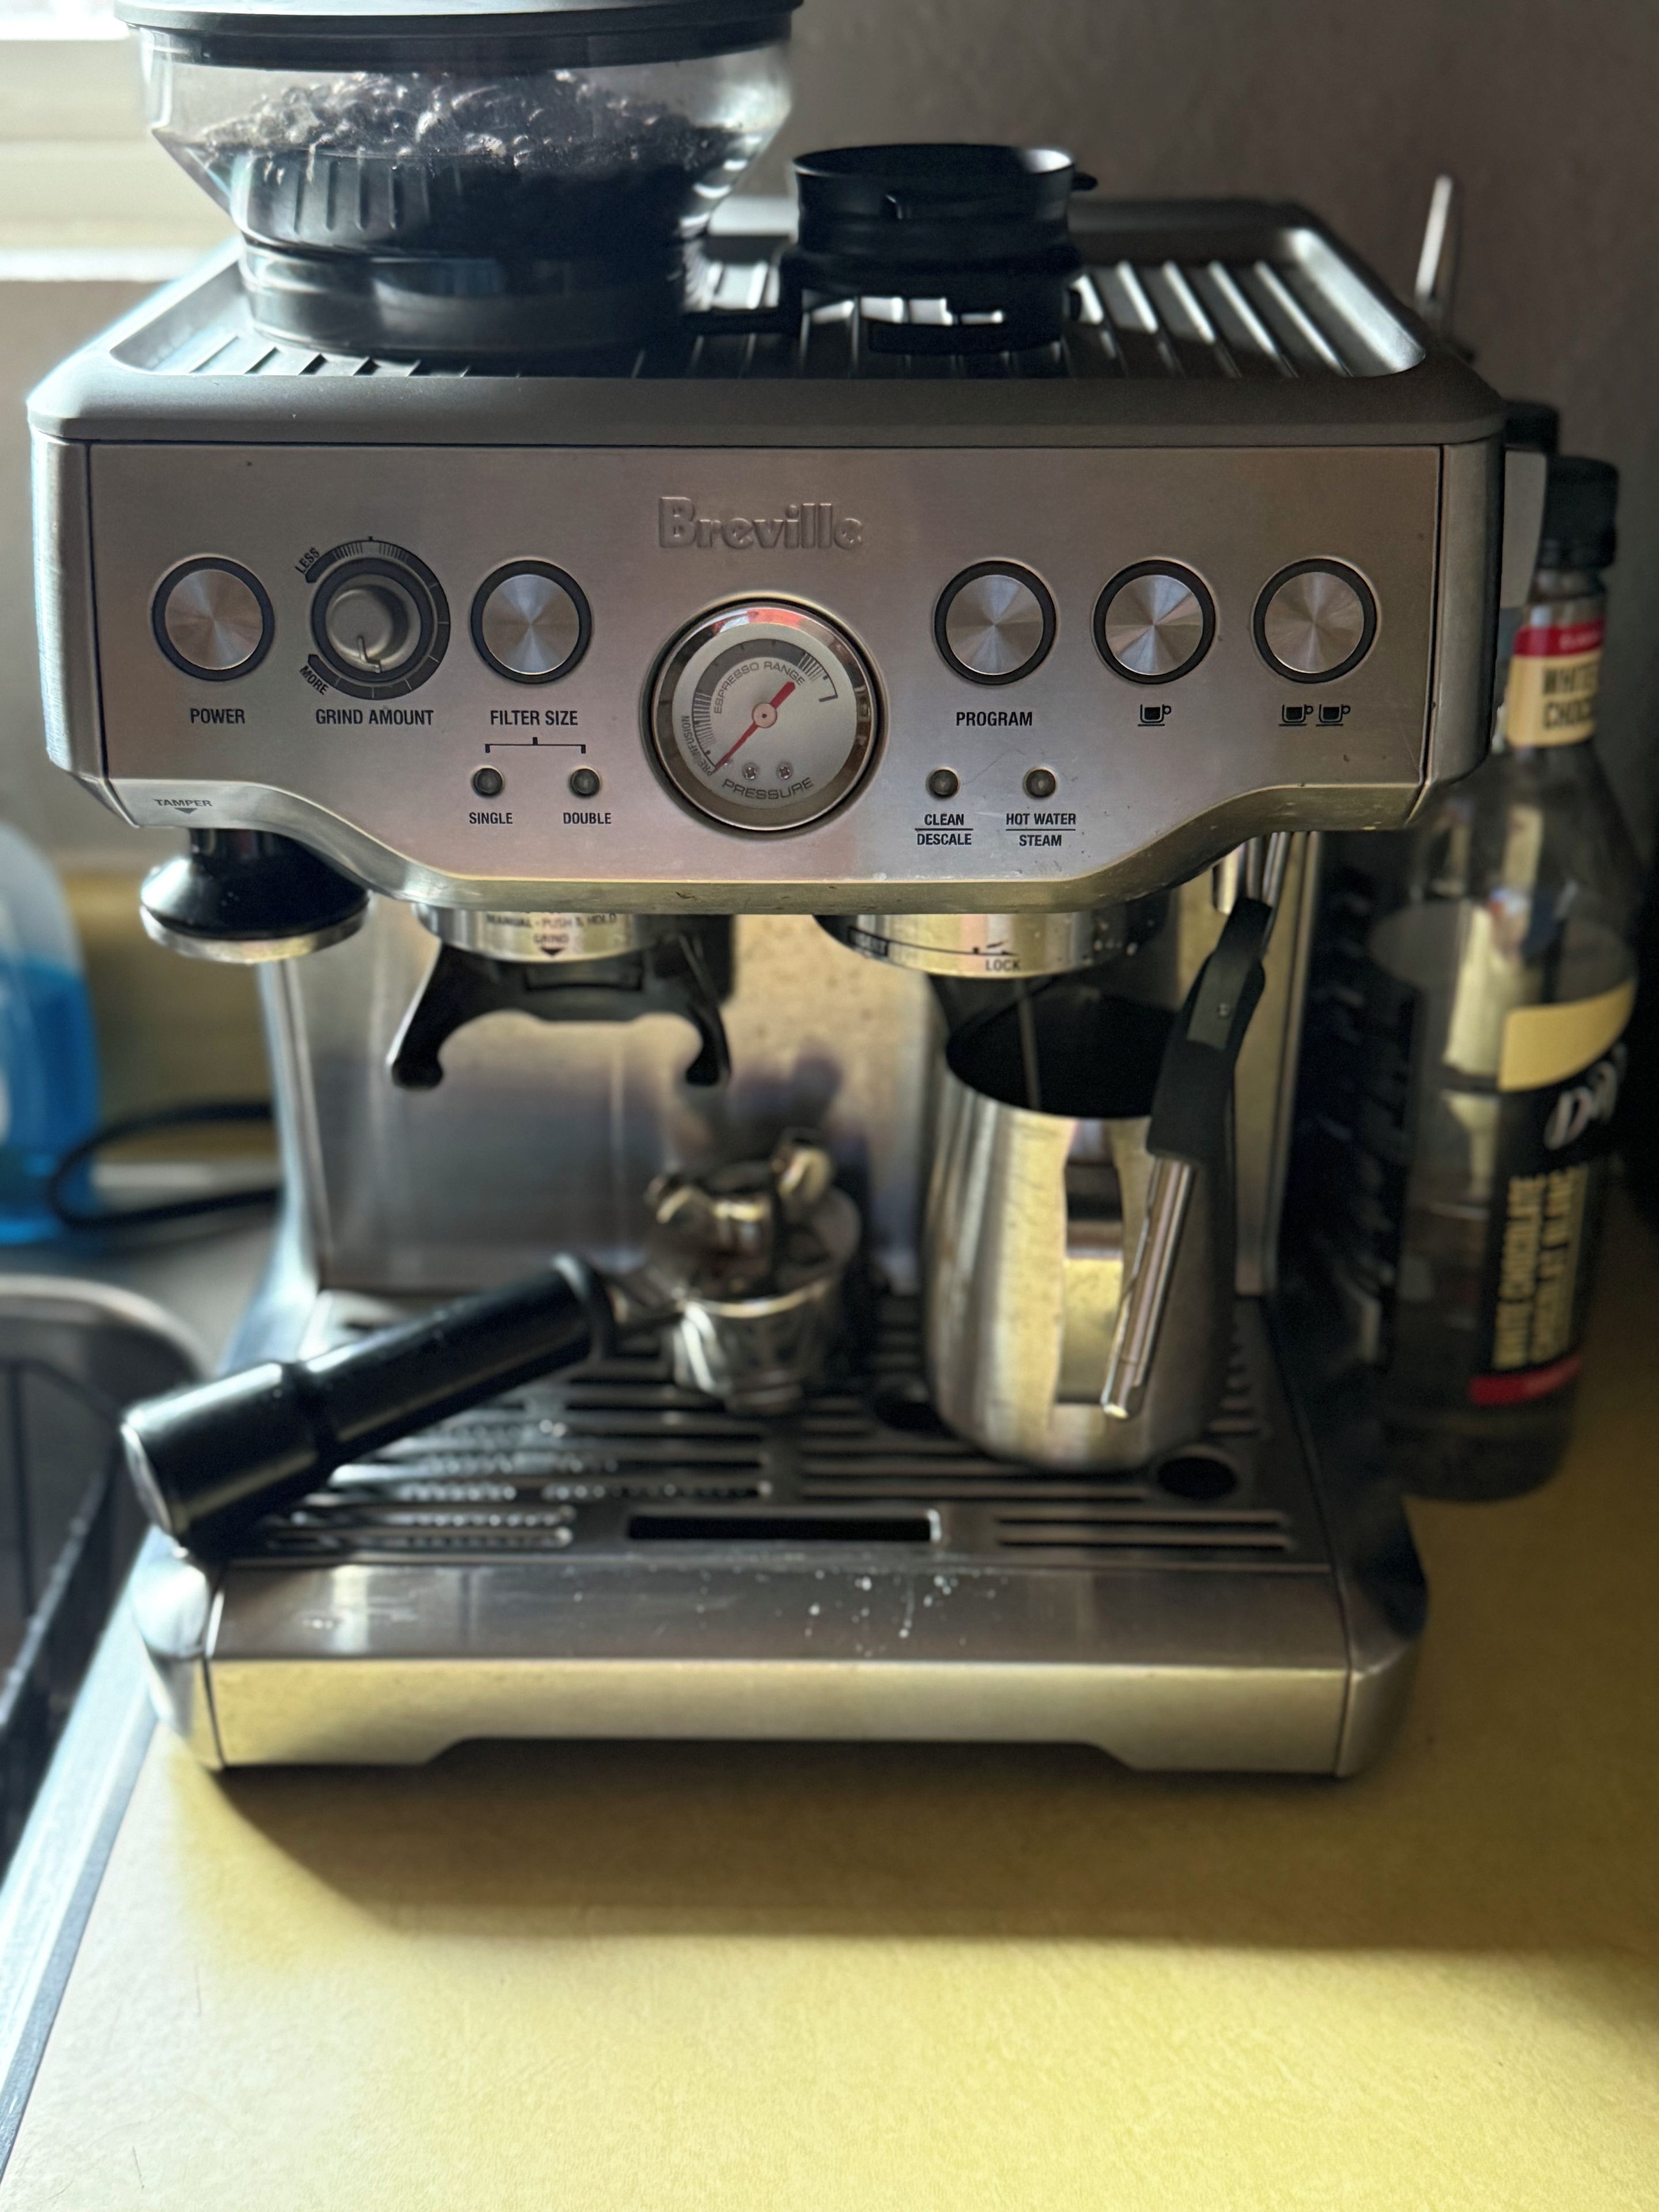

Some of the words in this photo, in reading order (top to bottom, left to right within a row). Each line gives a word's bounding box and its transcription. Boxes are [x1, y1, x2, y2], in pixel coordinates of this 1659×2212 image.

[658, 496, 863, 549] Breville
[295, 547, 320, 574] LESS
[300, 665, 329, 695] MORE
[714, 662, 760, 714] ESPRESSO
[763, 661, 806, 685] RANGE
[190, 708, 245, 724] POWER
[316, 709, 363, 725] GRIND
[368, 710, 434, 725] AMOUNT
[490, 710, 540, 725] FILTER
[545, 710, 578, 726] SIZE
[956, 711, 1033, 726] PROGRAM
[681, 715, 700, 758] NFUSION
[722, 777, 815, 800] PRESSURE
[153, 799, 213, 807] TAMPER
[469, 812, 513, 824] SINGLE
[563, 812, 612, 824] DOUBLE
[924, 813, 964, 825] CLEAN
[1006, 813, 1030, 825] HOT
[1034, 813, 1077, 825] WATER
[916, 833, 972, 846] DESCALE
[1019, 835, 1062, 846] STEAM
[986, 959, 1022, 972] LOCK
